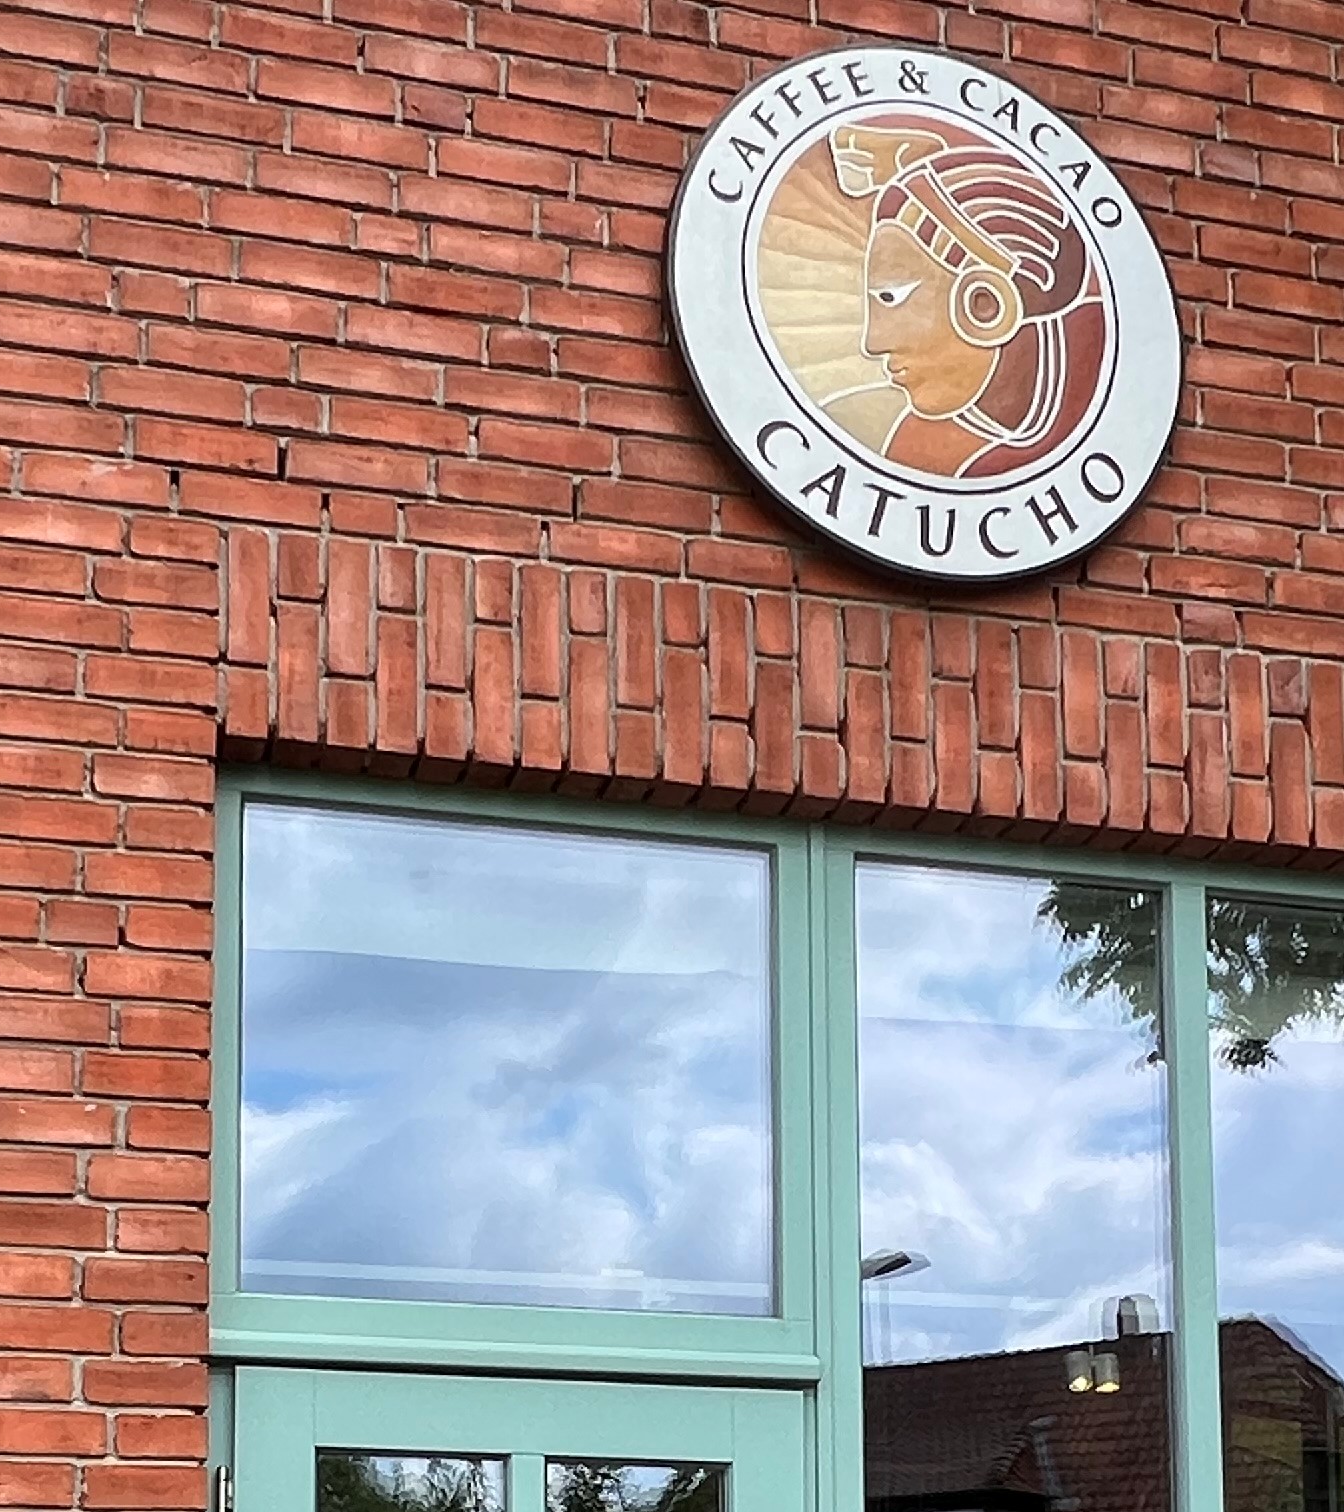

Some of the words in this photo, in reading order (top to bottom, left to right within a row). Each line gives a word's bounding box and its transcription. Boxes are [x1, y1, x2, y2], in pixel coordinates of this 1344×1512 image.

[708, 62, 875, 203] CAFFEE
[898, 60, 930, 95] &
[959, 77, 1122, 229] CACAO
[755, 419, 1126, 558] CATUCHO
